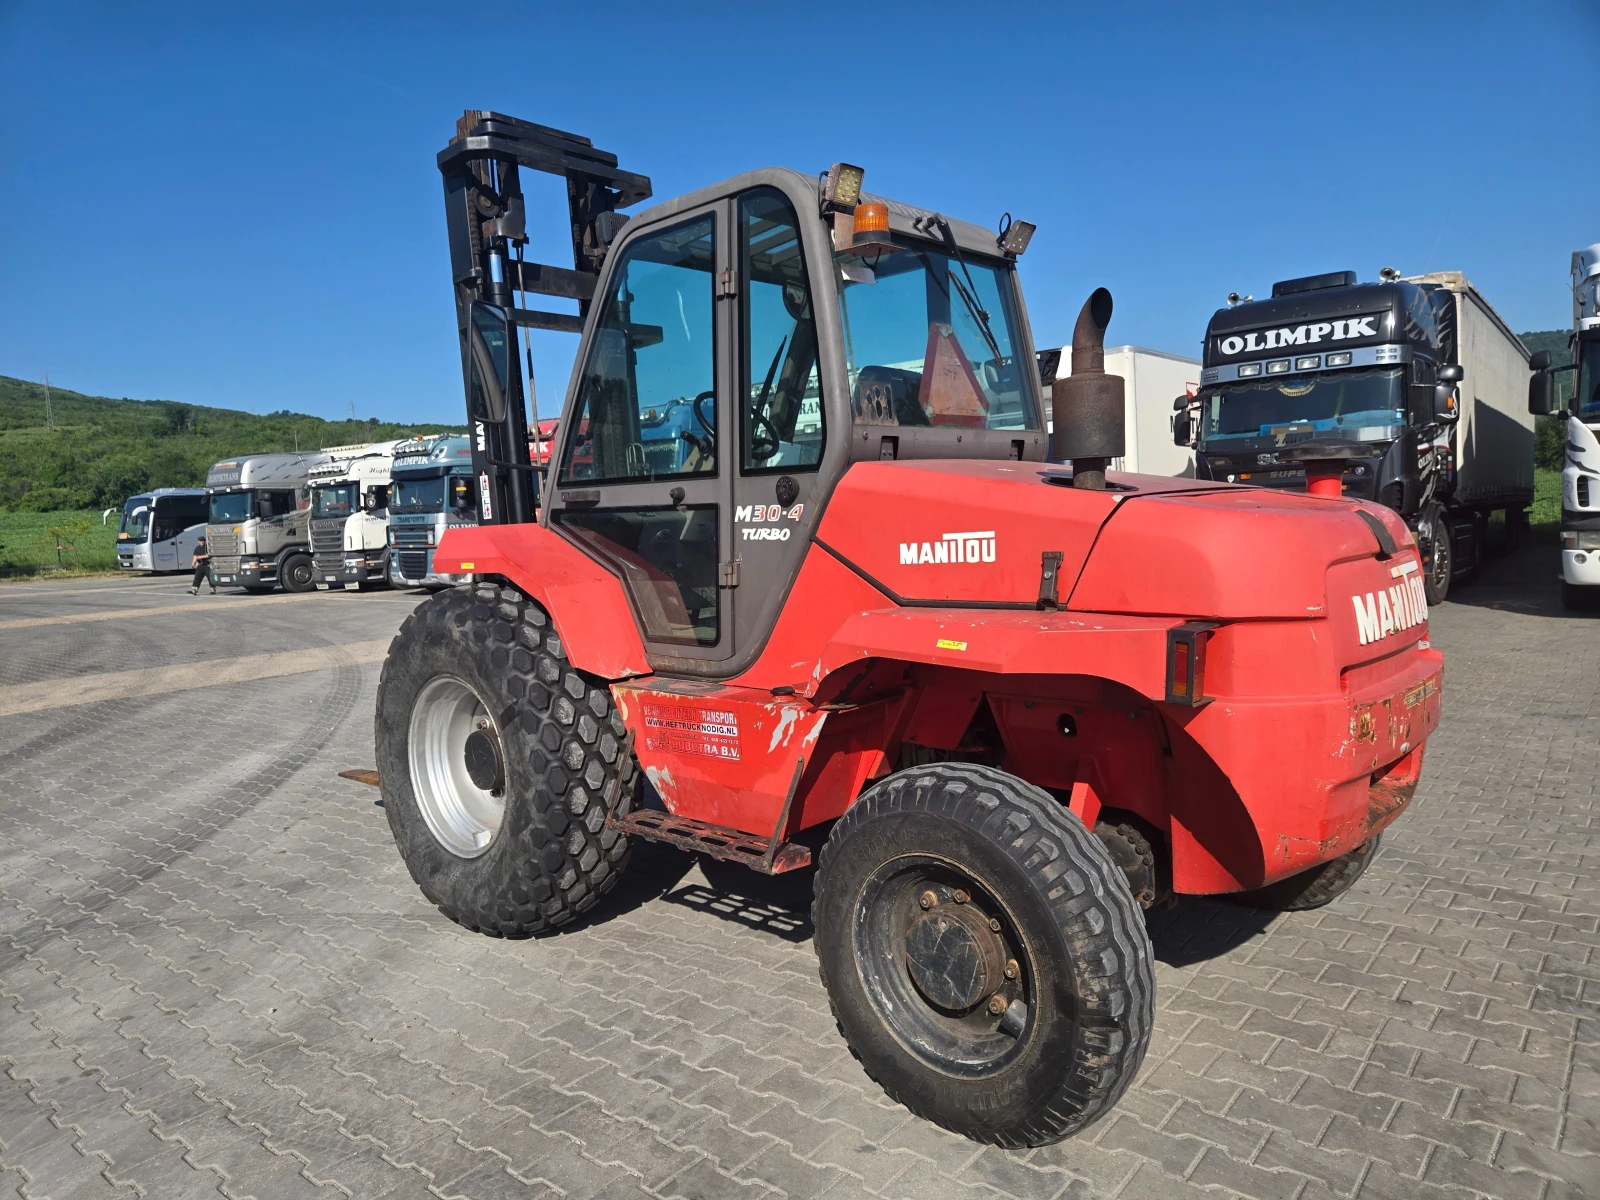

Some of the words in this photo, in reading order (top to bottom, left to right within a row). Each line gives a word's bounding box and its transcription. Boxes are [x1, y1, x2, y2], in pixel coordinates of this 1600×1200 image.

[1221, 316, 1377, 355] OLIMPIK
[475, 421, 485, 451] MA
[742, 528, 791, 541] TURBO
[899, 530, 996, 565] MANITOU
[1352, 560, 1429, 646] MANITOU
[647, 717, 737, 736] WWW.HEFTRUCKNODIG.NL
[721, 746, 740, 758] B.V.
